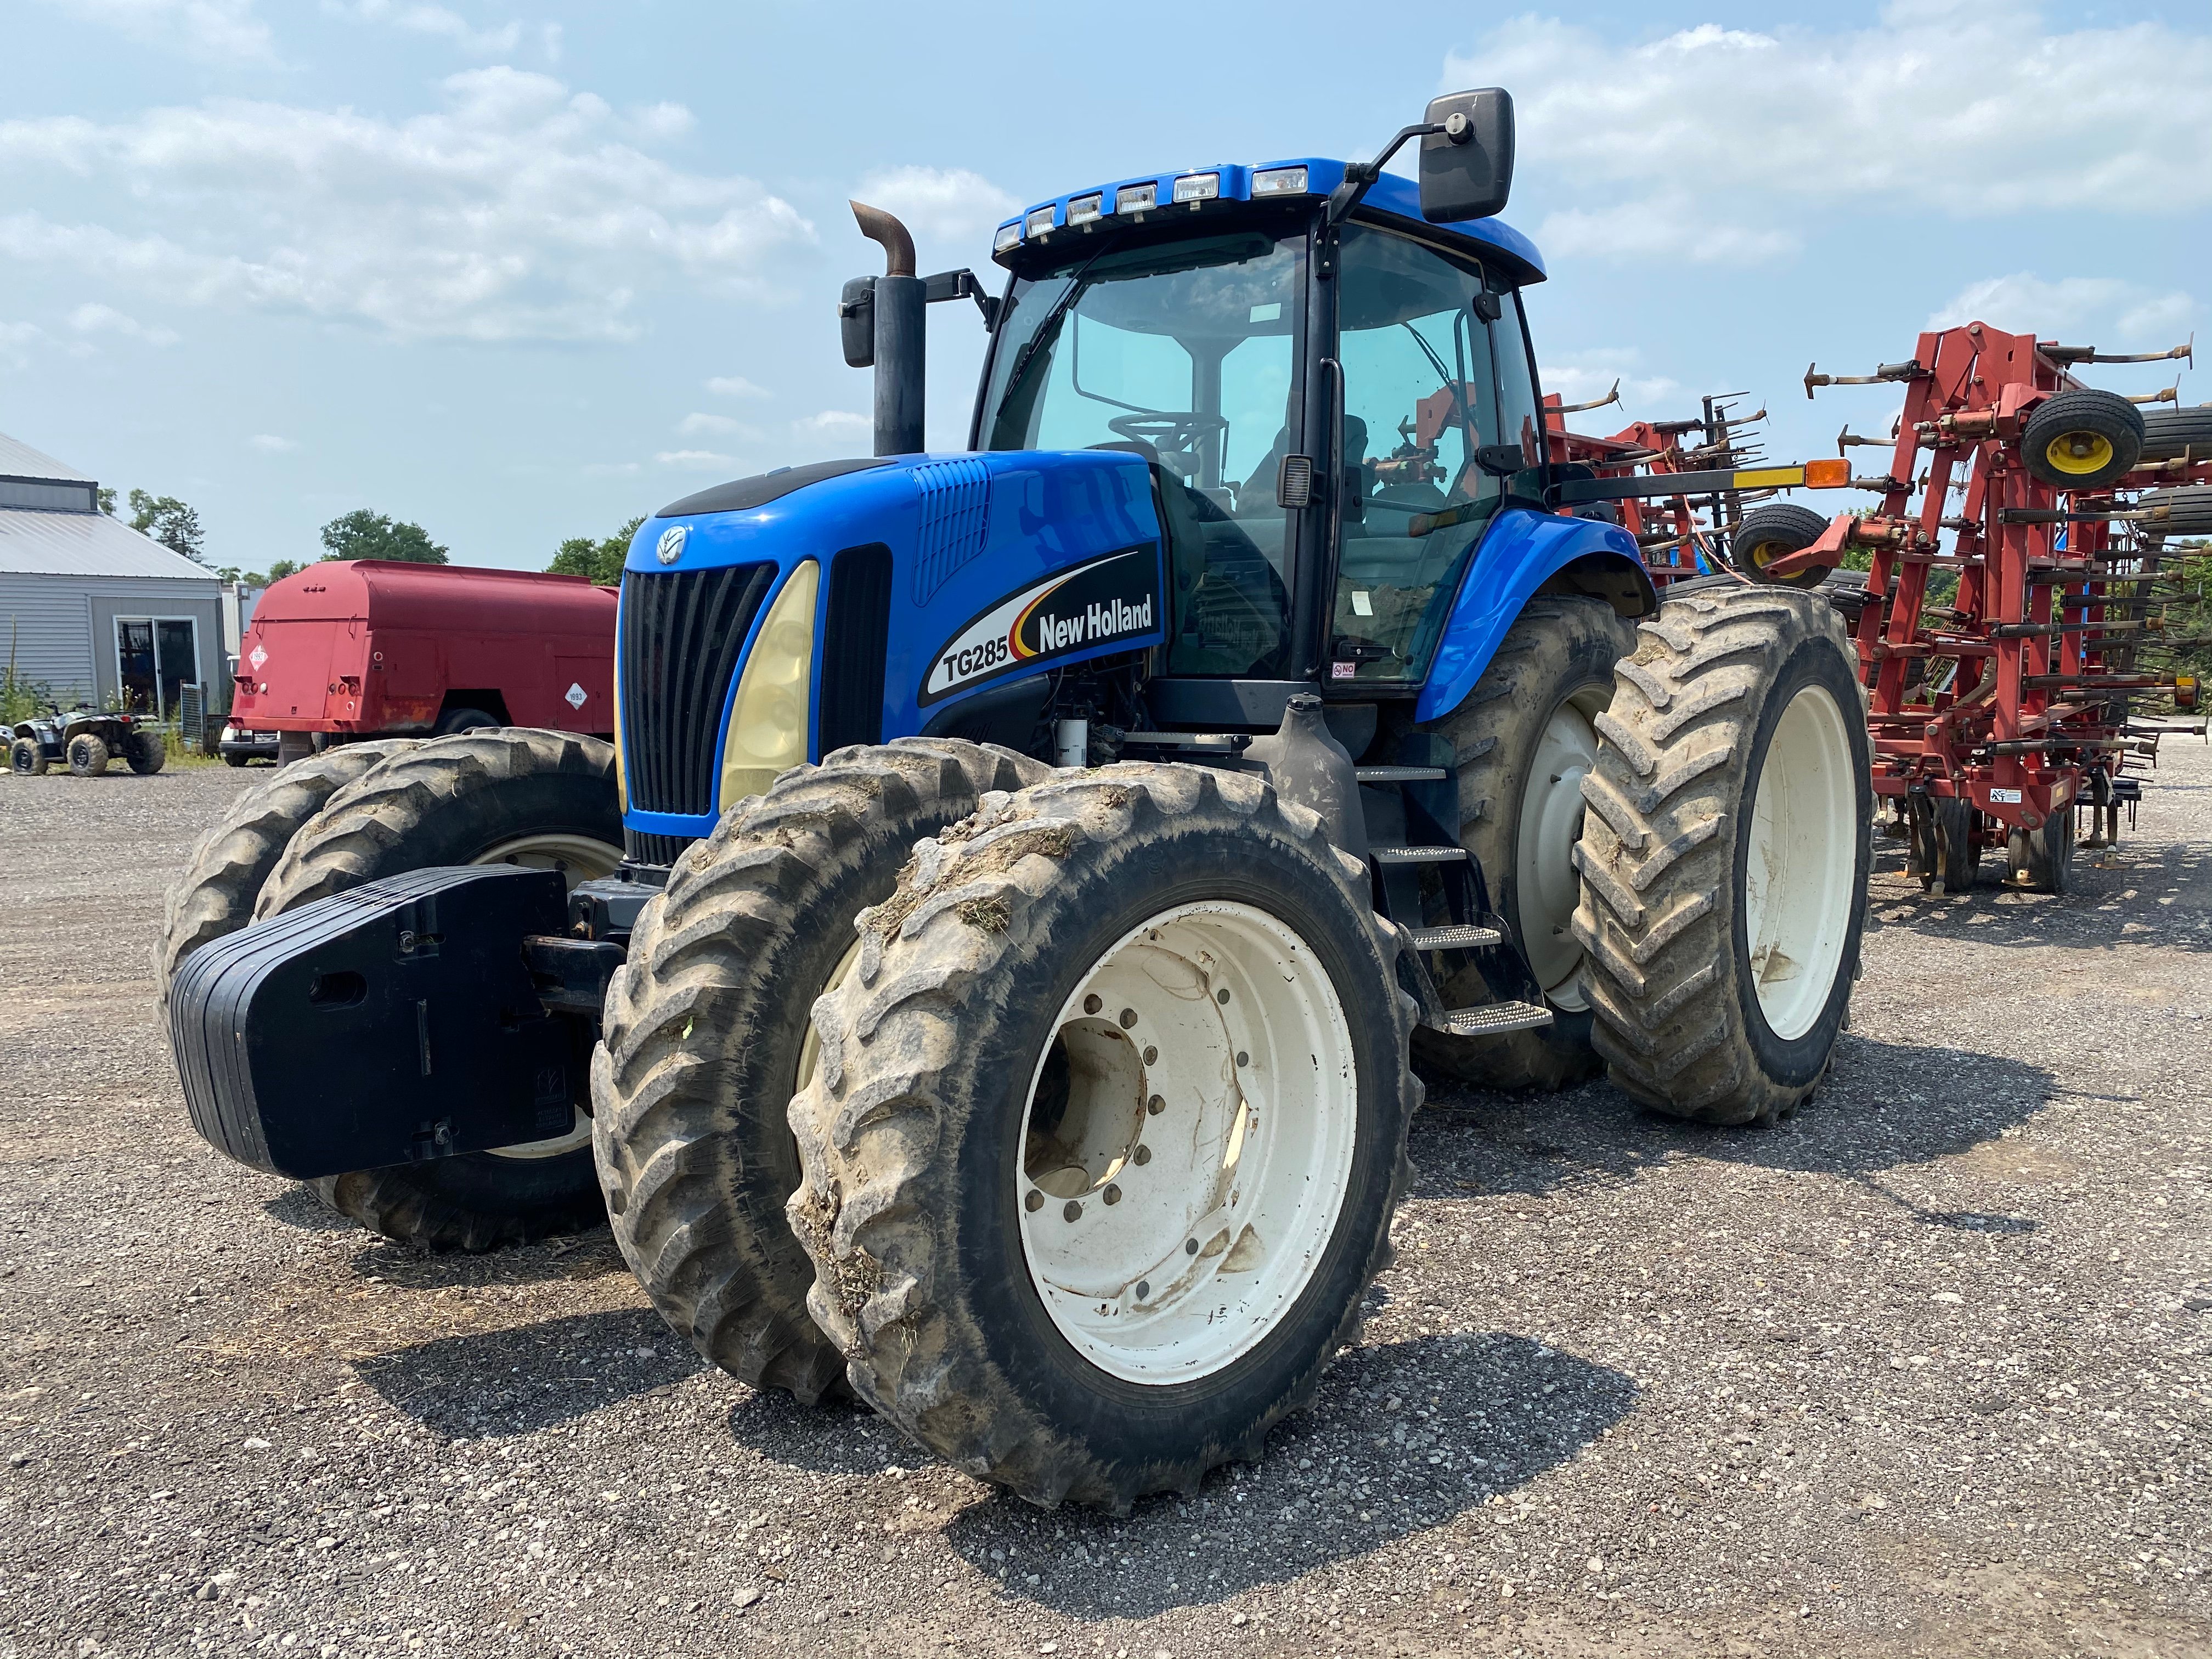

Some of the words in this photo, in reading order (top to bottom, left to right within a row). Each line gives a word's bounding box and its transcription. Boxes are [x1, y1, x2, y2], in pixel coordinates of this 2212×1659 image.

[1040, 614, 1085, 653] New
[1087, 594, 1151, 639] Holland
[943, 635, 1007, 681] TG285
